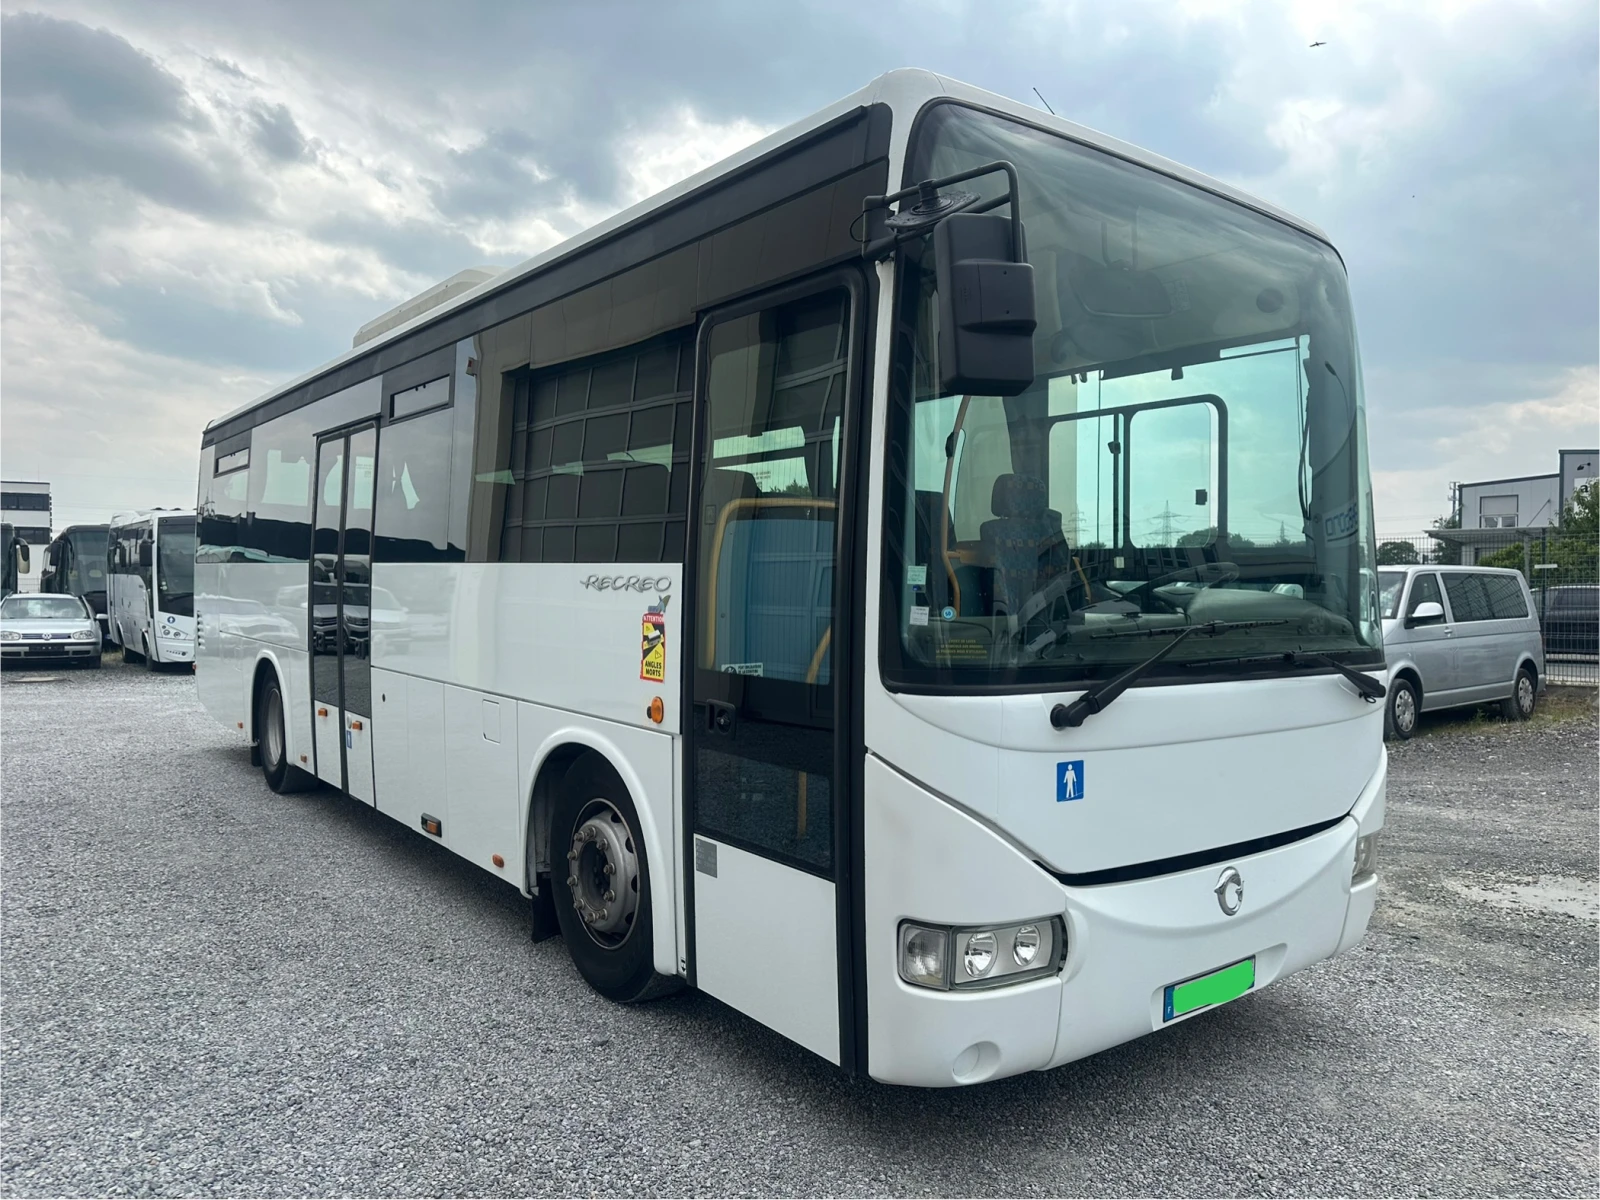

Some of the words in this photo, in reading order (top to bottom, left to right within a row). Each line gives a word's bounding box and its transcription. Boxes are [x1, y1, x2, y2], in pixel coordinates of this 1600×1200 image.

[580, 574, 672, 594] RECREO
[644, 660, 662, 669] ANGLES
[645, 668, 661, 677] MORTS
